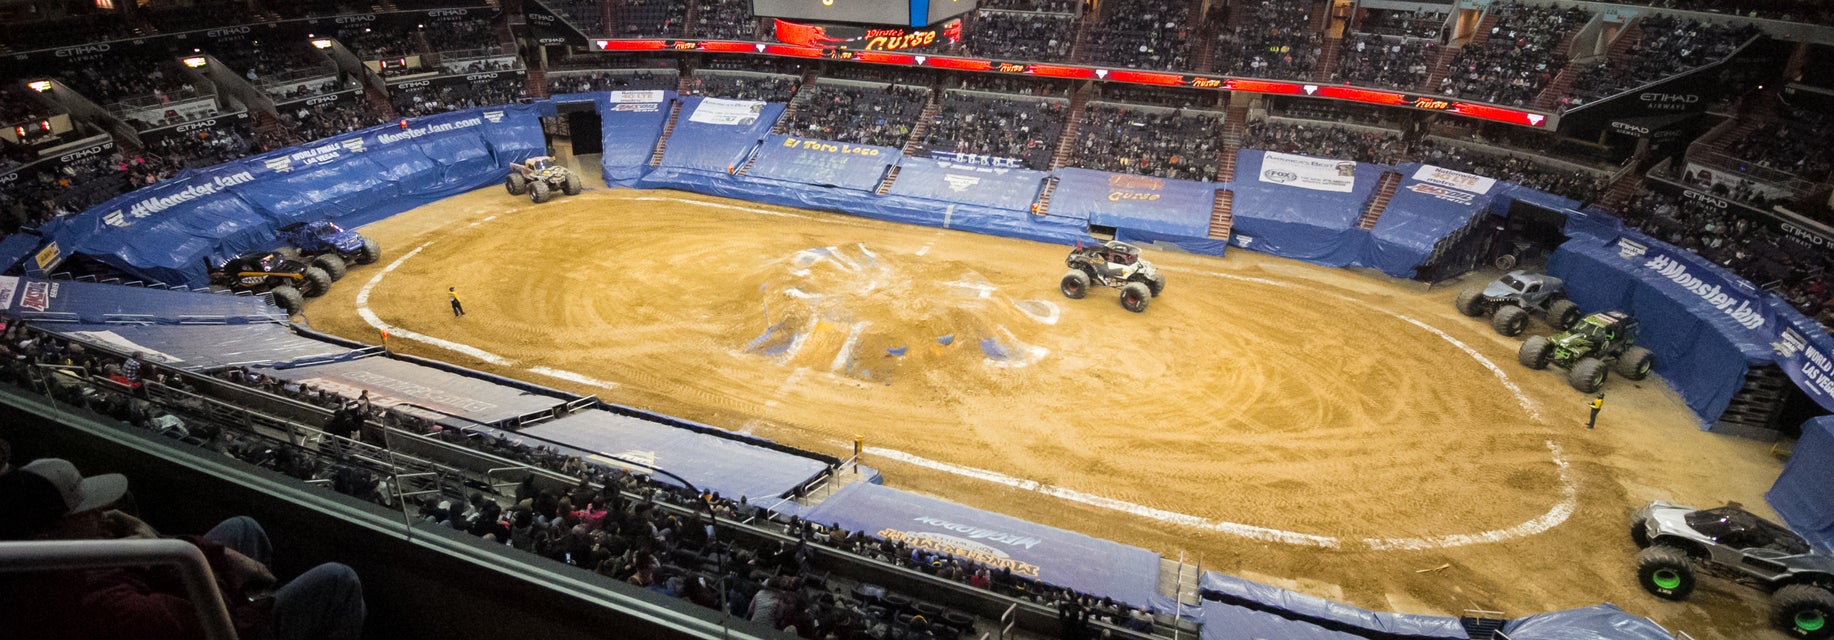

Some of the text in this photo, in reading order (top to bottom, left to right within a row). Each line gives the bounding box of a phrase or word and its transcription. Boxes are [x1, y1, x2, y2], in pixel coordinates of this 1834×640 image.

[428, 9, 468, 17] ETIHAD
[529, 13, 555, 22] ETIHAD
[335, 15, 376, 24] ETIHAD
[207, 26, 251, 37] ETIHAD
[865, 30, 936, 51] Curse
[55, 43, 111, 57] ETIHAD
[467, 73, 498, 81] ETIHAD
[398, 80, 430, 89] ETIHAD
[306, 95, 338, 105] ETIHAD
[1640, 92, 1699, 103] ETIHAD
[176, 120, 216, 132] ETIHAD
[1611, 121, 1649, 134] ETIHAD
[102, 142, 113, 150] 107
[803, 140, 838, 153] Toro
[841, 144, 879, 156] Loco
[60, 146, 102, 162] ETIHAD
[1270, 171, 1291, 179] FOX
[1435, 168, 1480, 181] Nationwide
[1426, 177, 1455, 187] metro
[1683, 190, 1728, 209] ETIHAD
[1781, 223, 1823, 245] ETIHAD
[1805, 346, 1832, 372] WORLD
[1801, 362, 1820, 379] LAS
